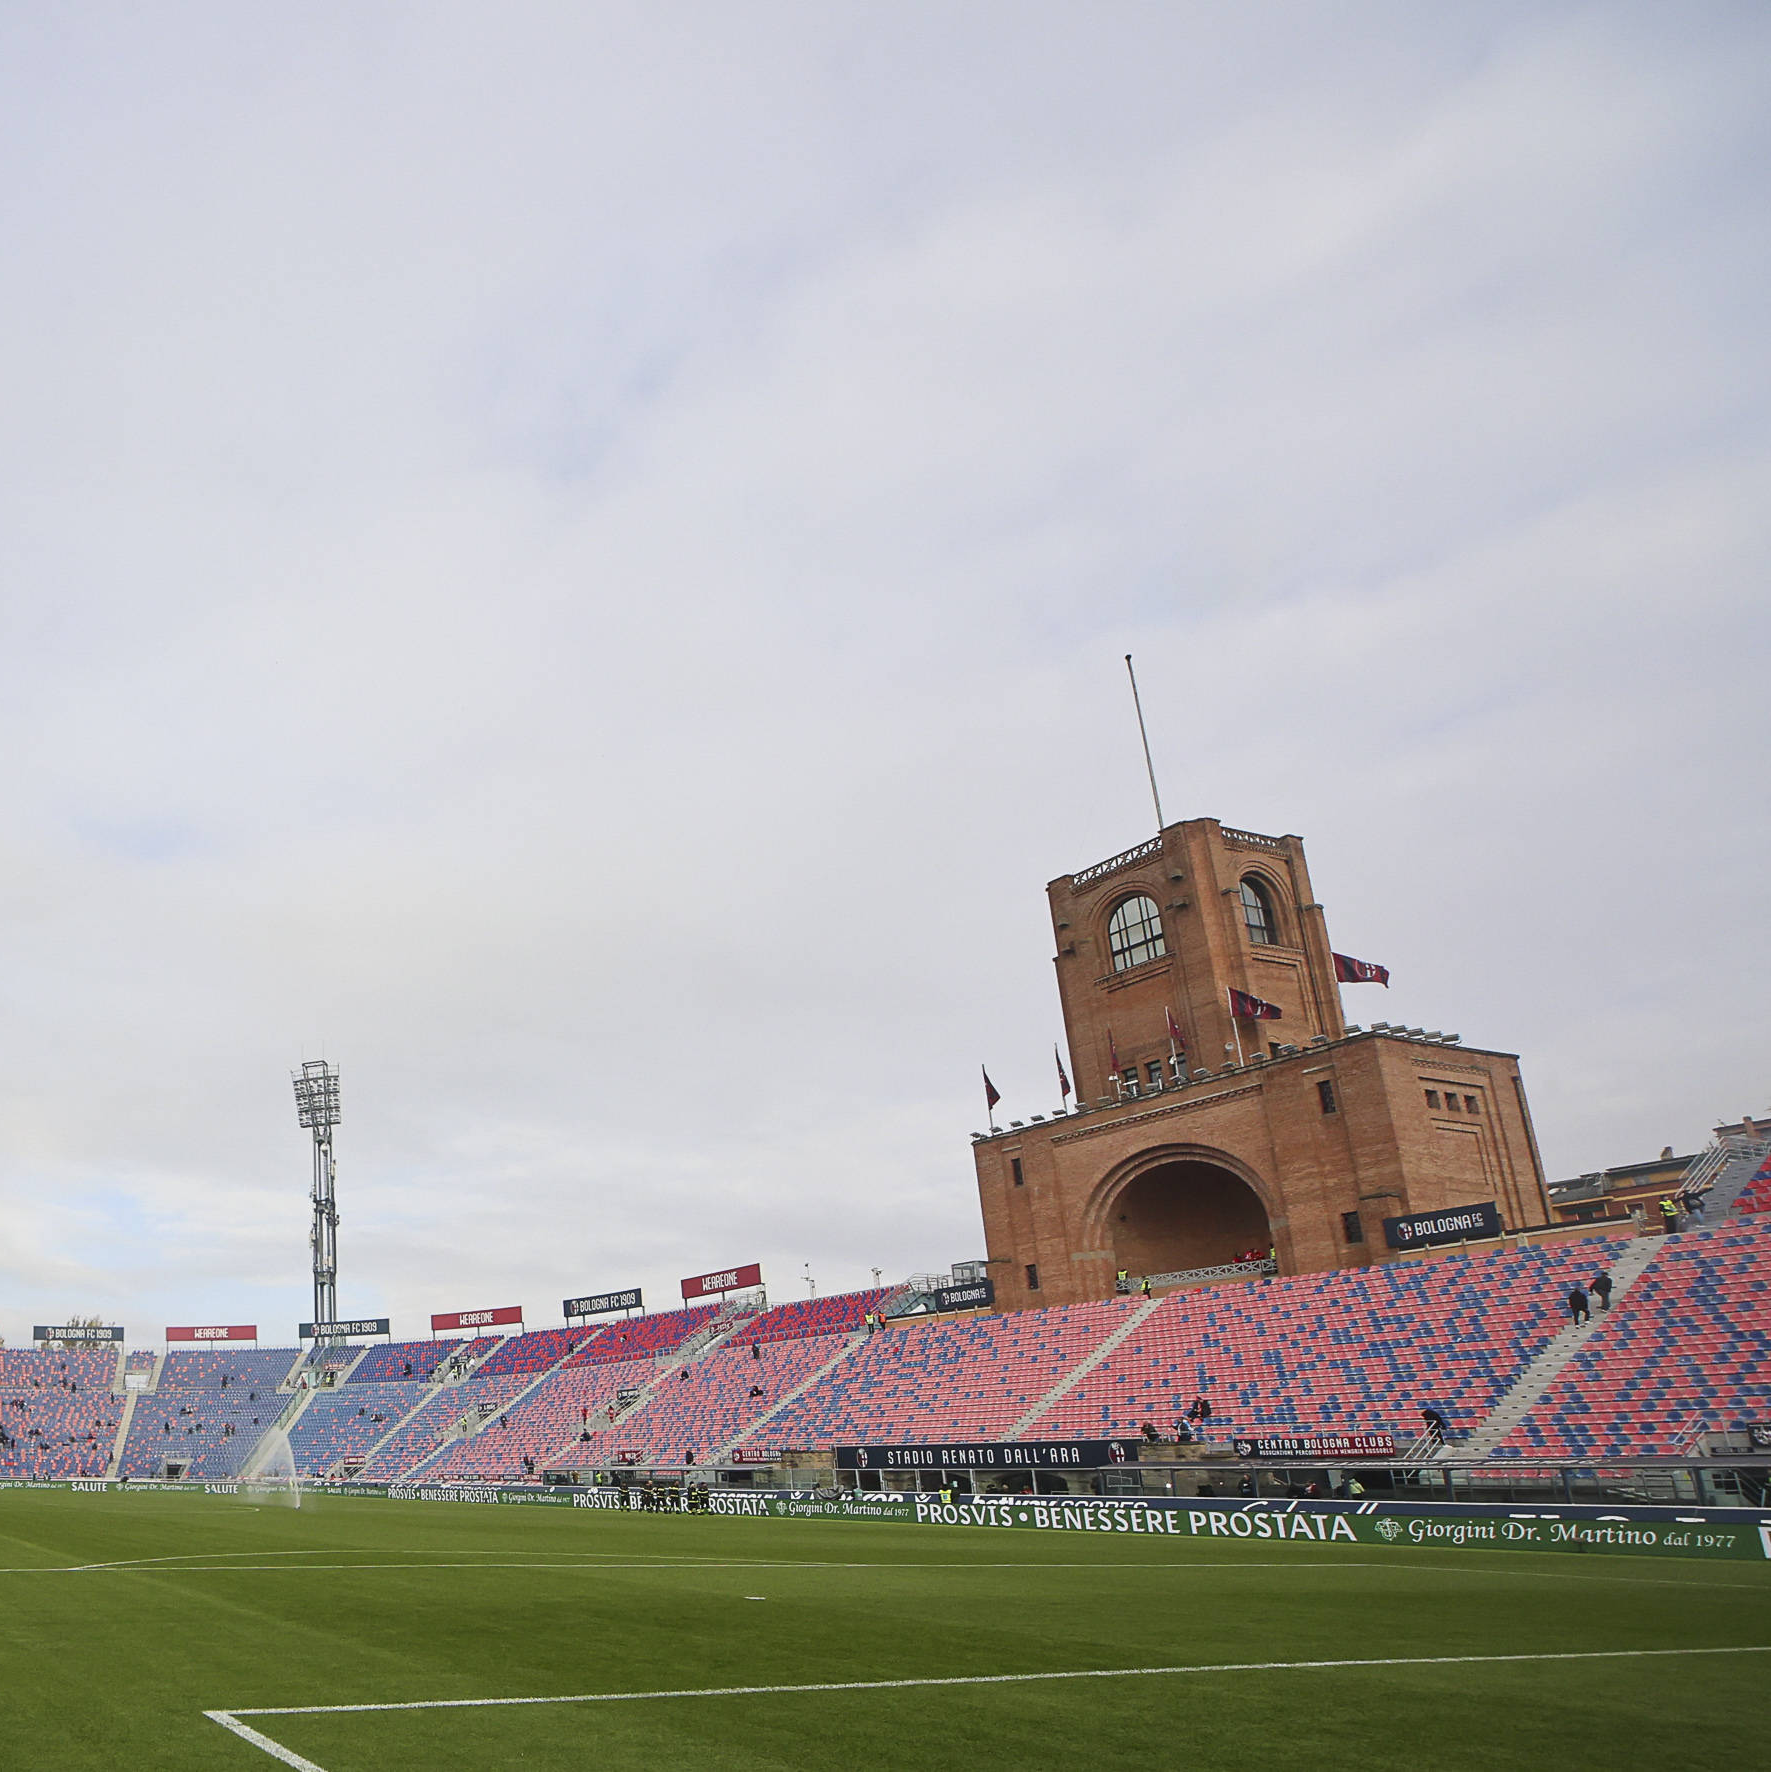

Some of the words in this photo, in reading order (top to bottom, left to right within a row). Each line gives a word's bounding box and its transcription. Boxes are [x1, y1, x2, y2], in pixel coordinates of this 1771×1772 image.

[1414, 1215, 1472, 1237] BOLOGNA
[1472, 1213, 1483, 1224] FC
[702, 1272, 738, 1291] WEAREONE
[580, 1297, 609, 1312] BOLOGNA
[610, 1294, 619, 1308] FC
[620, 1293, 636, 1306] 1909
[951, 1289, 980, 1303] BOLOGNA
[459, 1312, 494, 1325] WEAREONE
[55, 1328, 85, 1338] BOLOGNA
[87, 1328, 96, 1338] FC
[96, 1329, 112, 1338] 1909
[195, 1328, 228, 1338] WEAREONE
[320, 1324, 350, 1335] BOLOGNA
[352, 1323, 361, 1333] FC
[361, 1322, 377, 1332] 1909
[1257, 1439, 1298, 1449] CENTRO
[1304, 1437, 1349, 1449] BOLOGNA
[1355, 1436, 1392, 1448] CLUBS
[888, 1450, 933, 1465] STADIO
[942, 1449, 995, 1464] RENATO
[1003, 1447, 1080, 1464] DALL'ARA
[71, 1482, 108, 1492] SALUTE
[204, 1484, 238, 1494] SALUTE
[388, 1488, 416, 1500] PROSVIS
[420, 1489, 459, 1502] BENESSERE
[459, 1491, 499, 1504] PROSTATA
[573, 1494, 620, 1509] PROSVIS
[703, 1498, 769, 1516] ROSTATA
[789, 1501, 823, 1517] Giorgini
[824, 1502, 839, 1514] Dr.
[843, 1503, 882, 1516] Martino
[883, 1507, 893, 1516] dal
[895, 1509, 908, 1517] 1977
[916, 1503, 1012, 1527] PROSVIS
[1034, 1506, 1180, 1534] BENESSERE
[1189, 1511, 1358, 1542] PROSTATA
[1408, 1519, 1497, 1544] Giorgini
[1502, 1522, 1541, 1541] Dr.
[1551, 1522, 1657, 1545] Martino
[1663, 1531, 1691, 1547] dal
[1696, 1534, 1736, 1549] 1977
